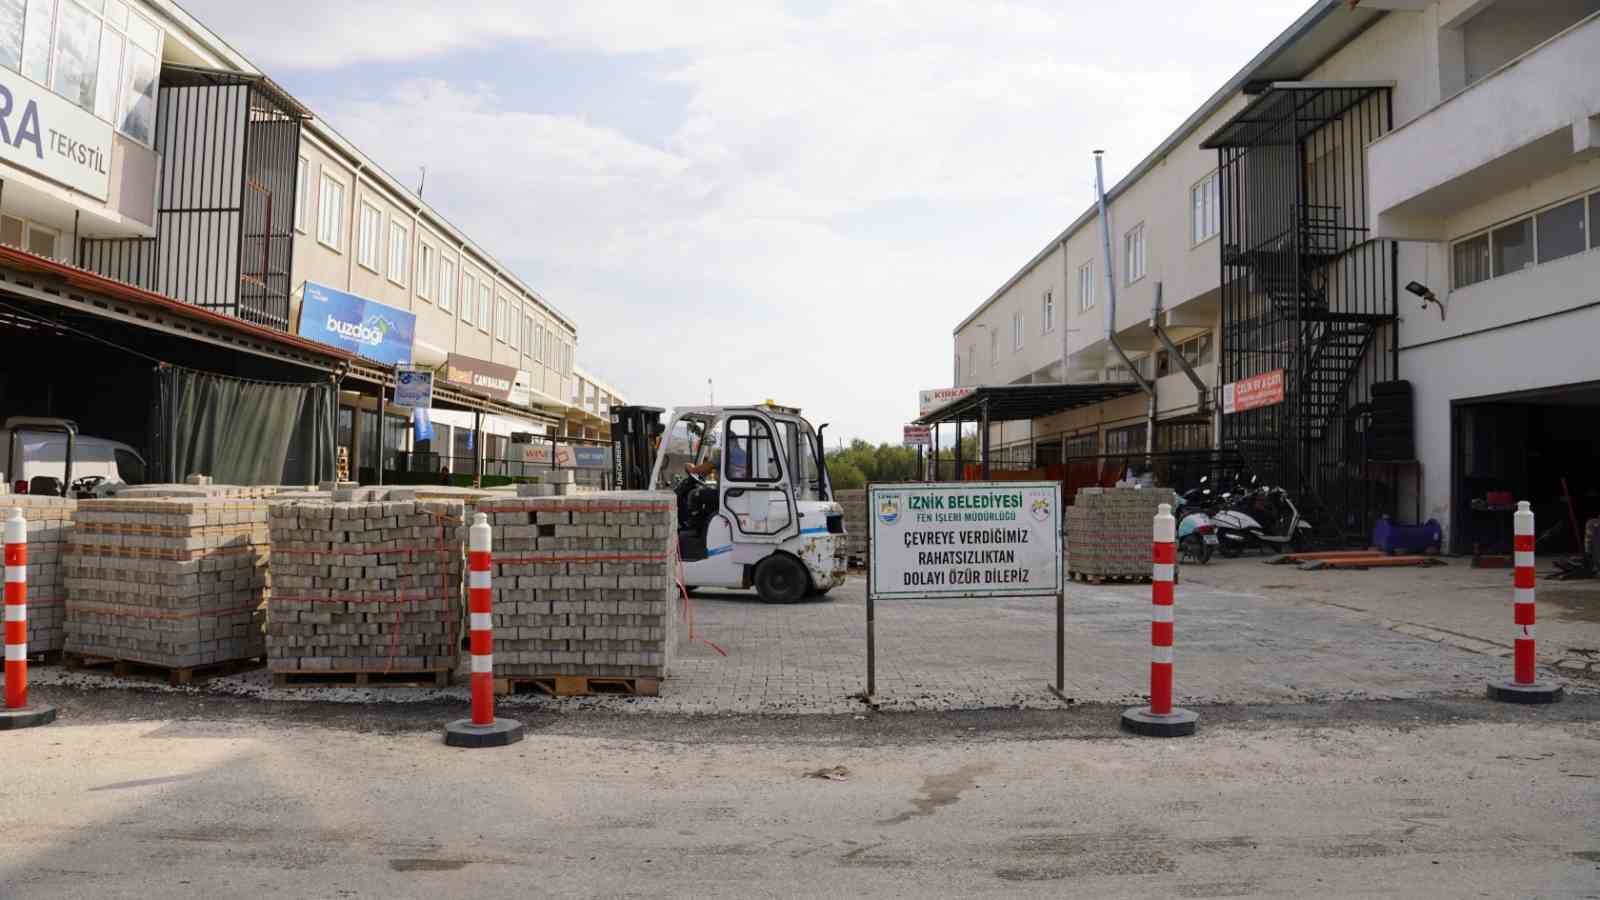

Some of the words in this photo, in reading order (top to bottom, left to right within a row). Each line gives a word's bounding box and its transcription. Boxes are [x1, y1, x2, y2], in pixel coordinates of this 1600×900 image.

[48, 128, 107, 175] TEKSTİL
[949, 491, 1023, 509] BELEDİYESİ
[916, 513, 932, 523] FEN
[935, 511, 961, 523] İŞLERİ
[964, 510, 1016, 521] MÜDÜRLÜĞÜ
[904, 531, 955, 548] ÇEVREYE
[959, 527, 1028, 544] VERDİĞİMİZ
[918, 550, 1015, 566] RAHATSIZLIKTAN
[904, 570, 945, 586] DOLAYI
[949, 567, 981, 584] ÖZÜR
